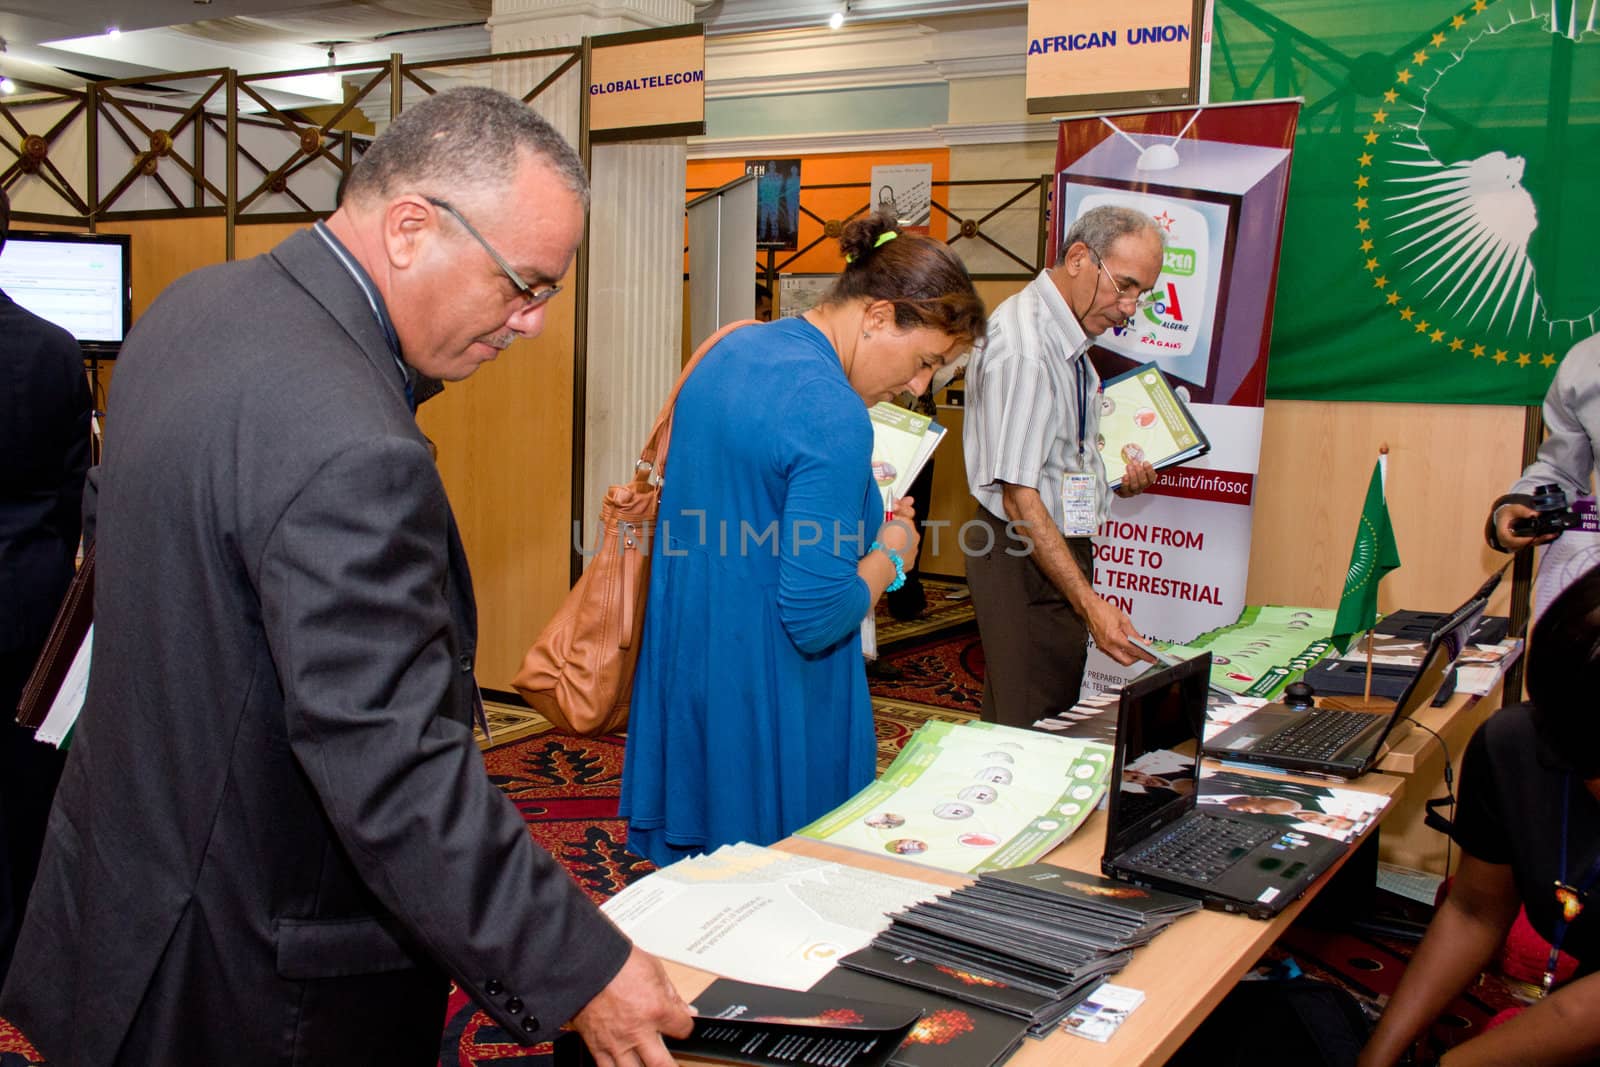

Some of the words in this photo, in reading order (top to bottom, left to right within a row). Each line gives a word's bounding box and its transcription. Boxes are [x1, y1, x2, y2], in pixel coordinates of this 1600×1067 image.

[1028, 31, 1117, 56] AFRICAN
[1126, 24, 1190, 45] UNION
[1151, 526, 1204, 551] FROM
[1138, 550, 1163, 570] TO
[1105, 569, 1223, 606] TERRESTRIAL
[1087, 670, 1122, 685] PREPARED
